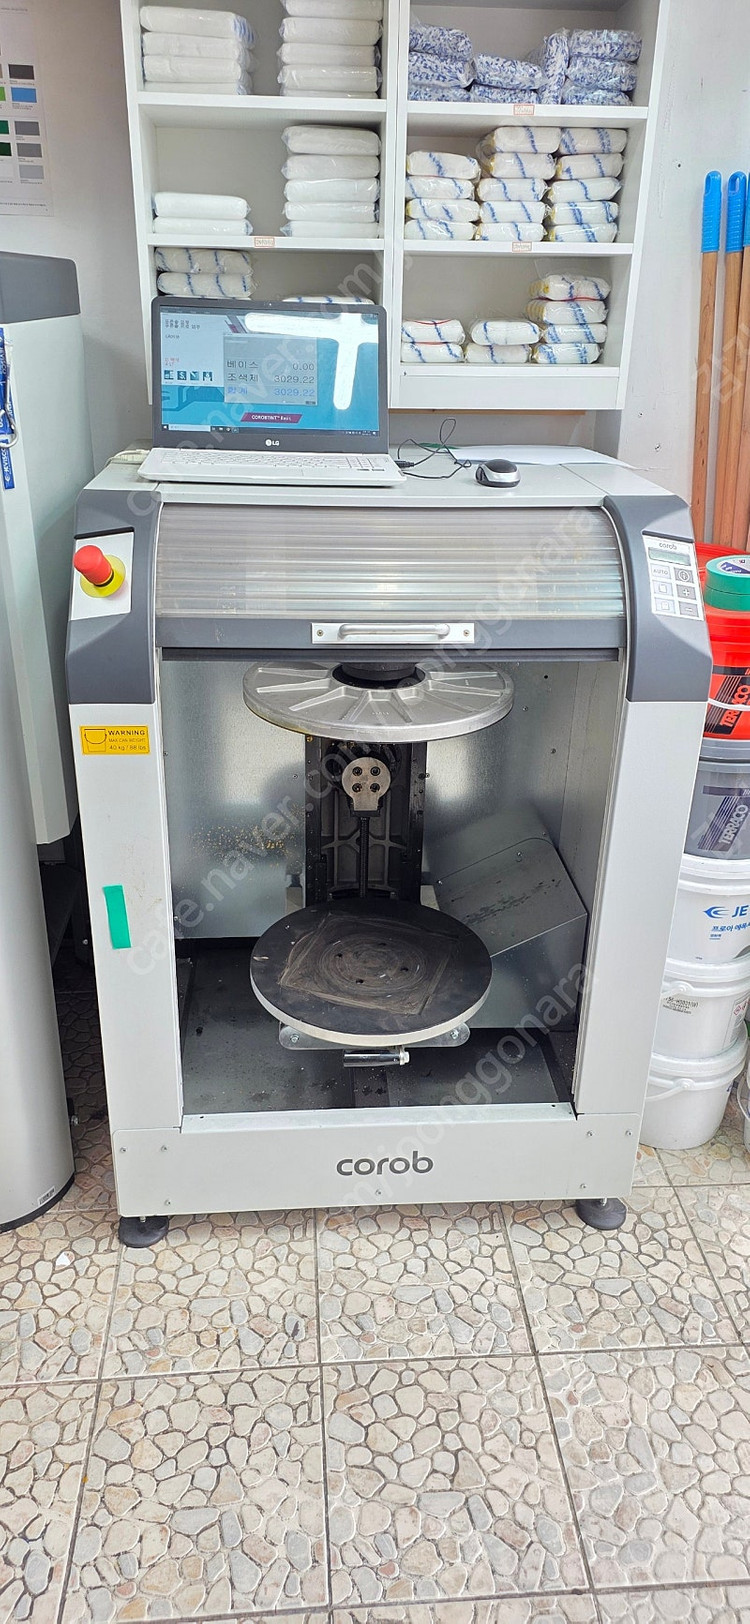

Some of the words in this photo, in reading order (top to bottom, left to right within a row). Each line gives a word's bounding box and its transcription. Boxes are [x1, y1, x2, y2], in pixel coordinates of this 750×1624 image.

[227, 360, 259, 369] 베이스
[292, 362, 315, 371] 0.00
[274, 375, 315, 383] 3029.22
[274, 388, 315, 397] 3029.22
[659, 542, 677, 550] corob
[720, 685, 750, 727] TERCO
[718, 803, 749, 844] TERRACO
[336, 1150, 434, 1176] corob
